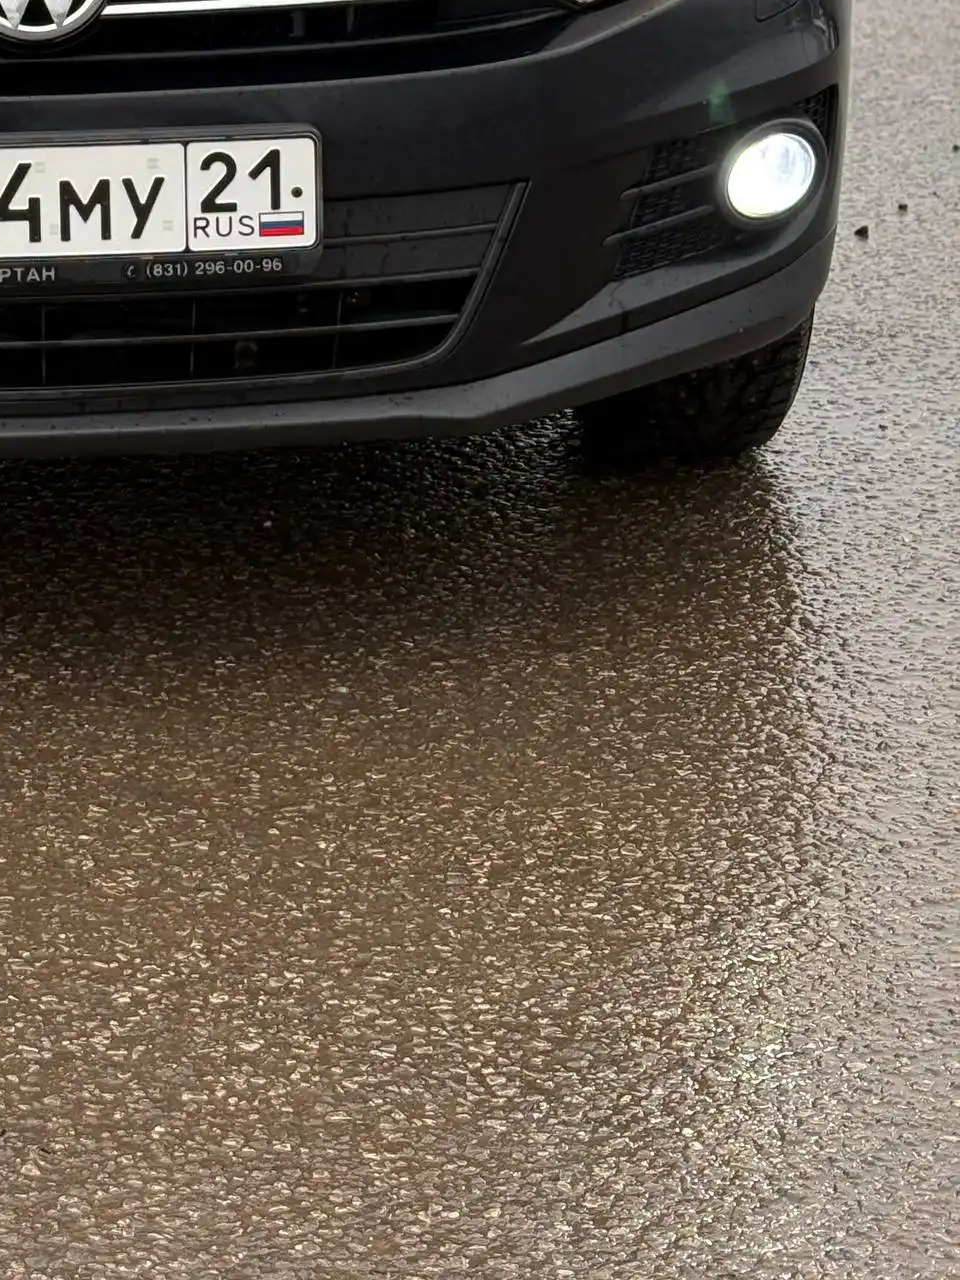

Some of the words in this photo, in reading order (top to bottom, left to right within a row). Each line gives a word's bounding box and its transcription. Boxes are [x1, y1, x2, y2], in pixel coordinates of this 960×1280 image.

[199, 148, 281, 214] 21
[193, 215, 255, 239] RUS
[145, 261, 189, 278] (831)
[194, 258, 283, 276] 296-00-96
